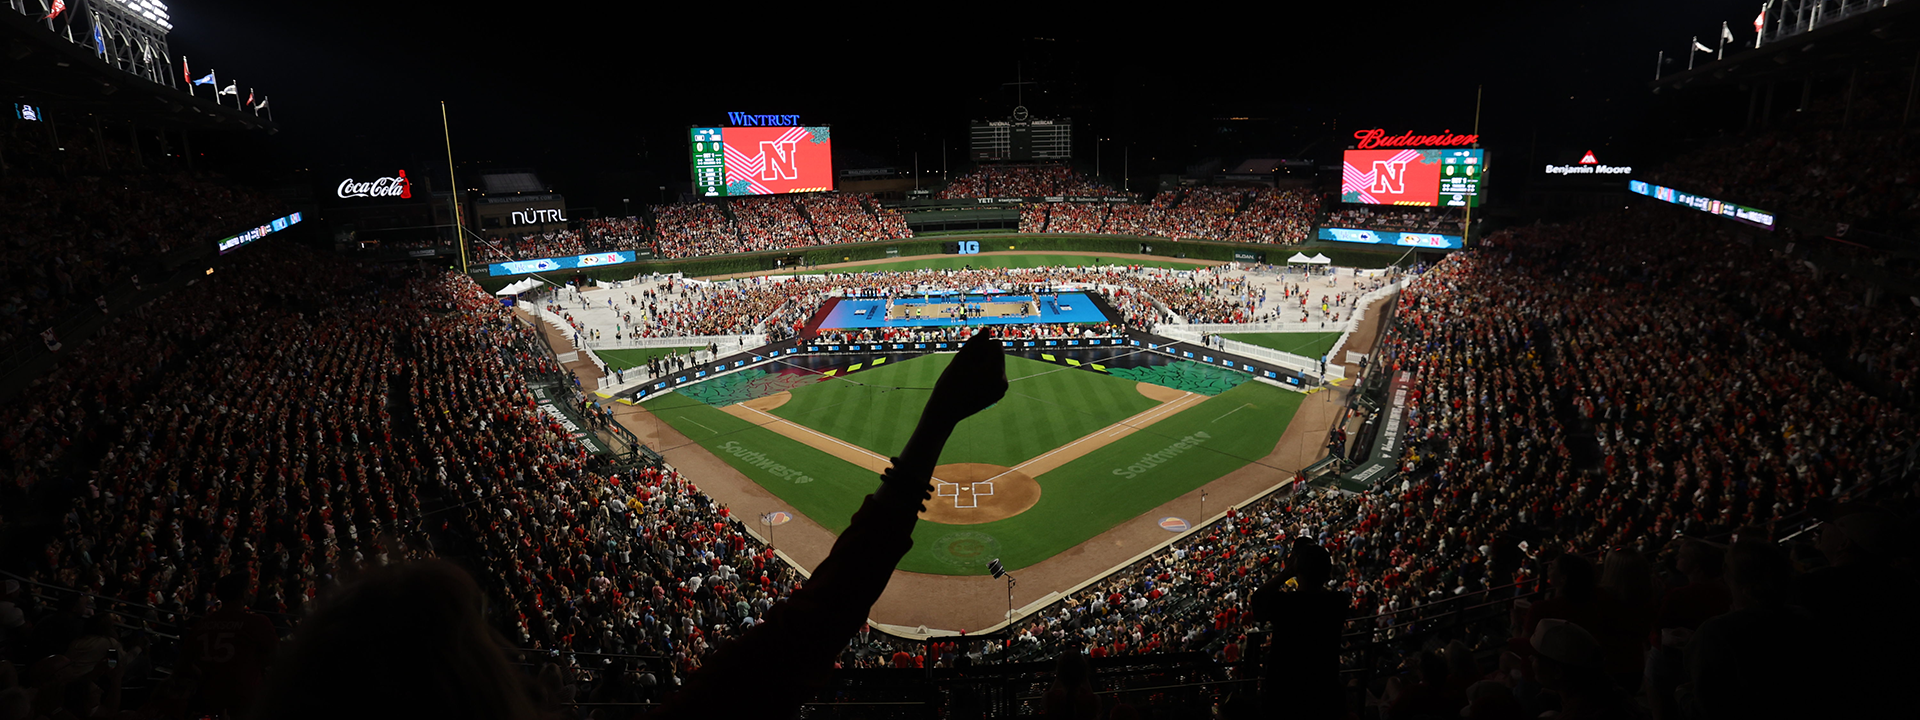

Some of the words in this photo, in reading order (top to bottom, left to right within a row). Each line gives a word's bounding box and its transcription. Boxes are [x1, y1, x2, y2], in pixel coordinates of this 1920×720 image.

[728, 112, 800, 126] WINTRUST
[1354, 128, 1478, 149] Budweiser
[759, 141, 797, 180] N
[1546, 164, 1593, 175] Benjamin
[1595, 165, 1631, 174] Moore
[338, 177, 405, 198] Coca-Cola
[1371, 161, 1406, 193] N
[1430, 237, 1440, 246] N
[608, 254, 616, 262] N
[716, 441, 803, 480] Southwest
[1112, 436, 1203, 479] Southwest
[196, 632, 236, 664] 15
